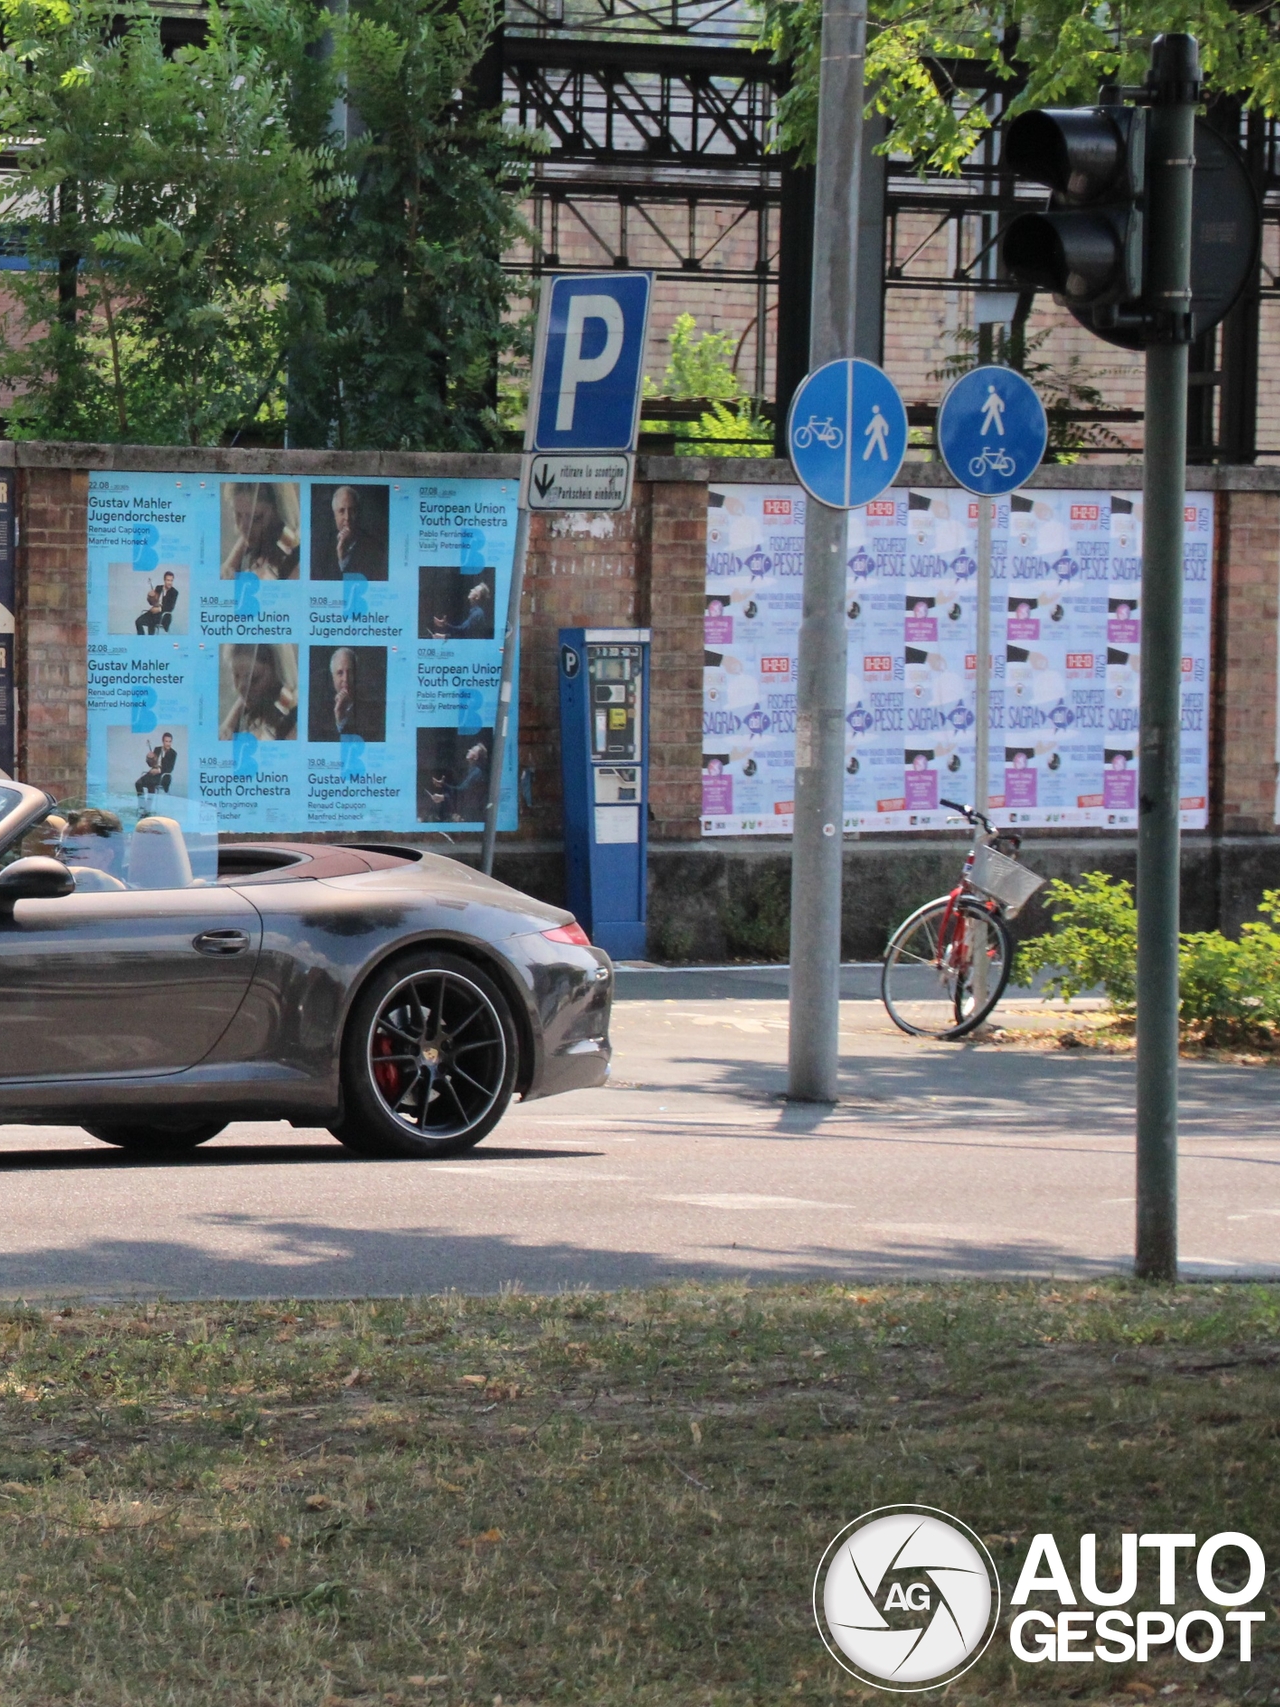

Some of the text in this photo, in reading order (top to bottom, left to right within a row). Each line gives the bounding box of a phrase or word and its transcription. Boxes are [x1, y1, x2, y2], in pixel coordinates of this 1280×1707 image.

[555, 295, 624, 431] P
[560, 465, 623, 477] ritirare lo scontrino
[558, 487, 591, 499] Parkschein
[89, 497, 172, 509] Gustav Mahler
[420, 502, 505, 515] European Union
[88, 511, 186, 524] Jugendorchester
[794, 500, 805, 524] 2025
[897, 502, 907, 526] 2025
[998, 505, 1009, 528] 2025
[1100, 506, 1110, 530] 2025
[1199, 508, 1209, 531] 2025
[420, 515, 507, 526] Youth Orchestra
[88, 526, 150, 535] Renaud Capuçon
[88, 537, 119, 545] Manfred
[419, 542, 438, 551] Vasily
[773, 553, 804, 576] PESCE
[877, 554, 906, 576] PESCE
[910, 555, 941, 577] SAGRA
[1013, 557, 1043, 579] SAGRA
[1080, 558, 1109, 580] PESCE
[1184, 559, 1207, 581] ESCE
[310, 597, 328, 605] 19.08
[201, 612, 289, 626] European Union
[310, 612, 389, 623] Gustav Mahler
[201, 624, 292, 635] Youth Orchestra
[309, 626, 402, 638] Jugendorchester
[88, 660, 169, 671] Gustav Mahler
[418, 663, 468, 675] European
[565, 653, 575, 672] P
[894, 657, 905, 680] 2025
[995, 655, 1005, 679] 2025
[1095, 654, 1106, 678] 2025
[1195, 659, 1205, 682] 2025
[87, 673, 184, 686] Jugendorchester
[418, 677, 499, 687] Youth Orchestr
[117, 689, 148, 697] Capuçon
[768, 694, 797, 709] FISCHFES
[703, 710, 796, 734] SAGRA PESC
[875, 708, 904, 731] PESCE
[908, 708, 939, 731] SAGRA
[1009, 706, 1040, 728] SAGRA
[1076, 706, 1104, 727] PESCE
[1181, 709, 1203, 730] ESCE
[200, 772, 288, 787] European Union
[308, 774, 387, 784] Gustav Mahler
[200, 785, 290, 796] Youth Orchestra
[308, 786, 400, 799] Jugendorchester
[336, 802, 366, 810] Capuçon
